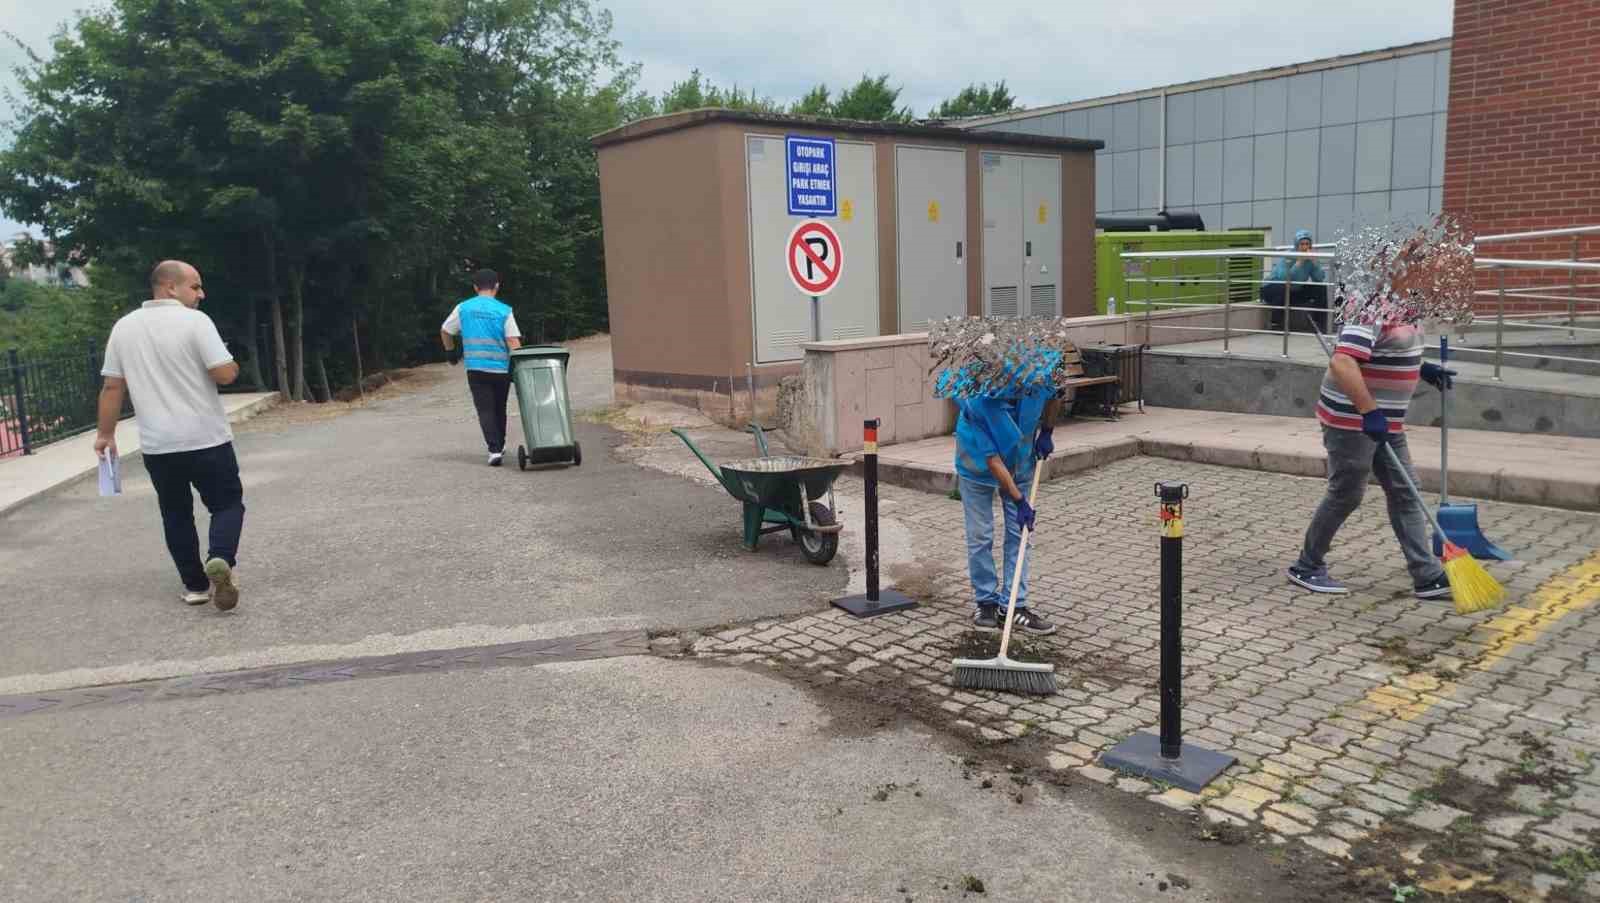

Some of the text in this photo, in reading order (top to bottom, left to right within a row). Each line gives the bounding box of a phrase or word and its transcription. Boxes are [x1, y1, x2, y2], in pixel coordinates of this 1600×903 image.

[796, 145, 825, 159] OTOPARK
[812, 163, 829, 178] ARAÇ
[793, 178, 831, 190] PARK ETMEK
[797, 194, 826, 206] YASAKTIR
